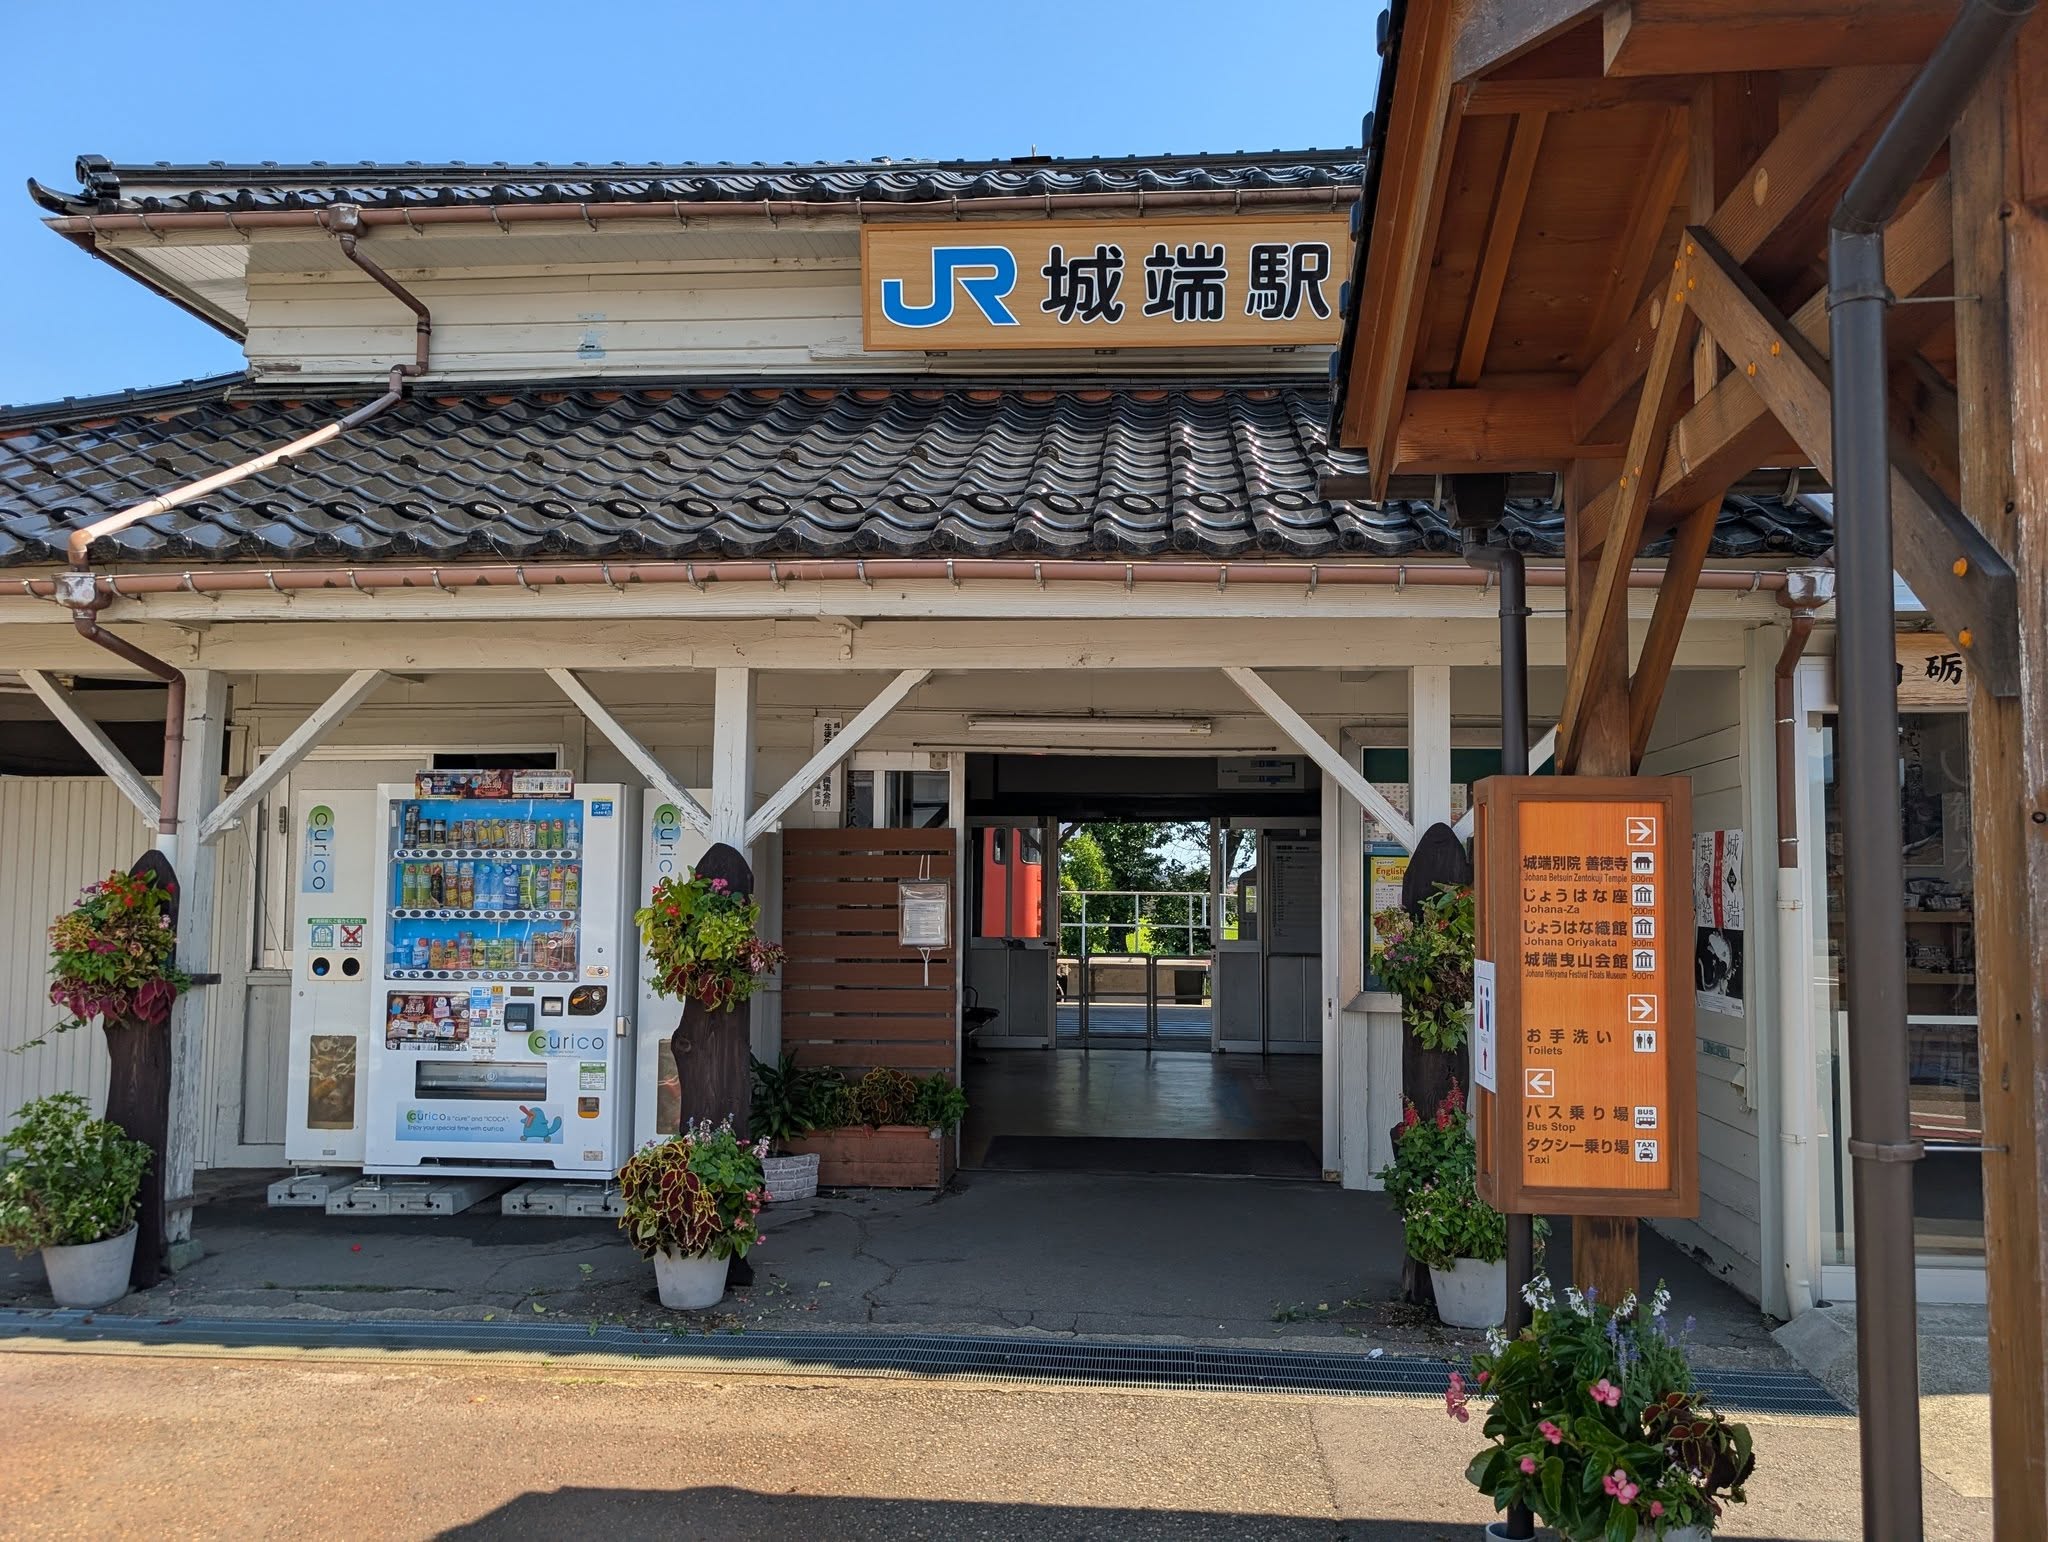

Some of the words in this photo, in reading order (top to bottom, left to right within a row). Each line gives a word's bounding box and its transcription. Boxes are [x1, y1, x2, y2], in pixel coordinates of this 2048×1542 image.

[882, 245, 1020, 328] JR
[1041, 240, 1332, 325] 城端駅
[312, 812, 330, 890] curico
[1523, 855, 1581, 871] 城端別院
[1586, 855, 1628, 872] 善徳寺
[1376, 867, 1405, 877] English
[1524, 873, 1547, 881] Johana
[1549, 873, 1573, 882] Betsuin
[1574, 873, 1603, 884] Zentokuji
[1604, 874, 1628, 884] Temple
[1523, 887, 1628, 904] じょうはな座
[1524, 904, 1580, 914] Johana-Za
[1629, 907, 1656, 915] 1200m
[1523, 919, 1628, 936] じょうはな織館
[1524, 937, 1564, 947] Johana
[1566, 937, 1617, 948] Oriyakata
[1631, 939, 1655, 947] 900m
[1524, 951, 1628, 969] 城端曳山会館
[1525, 970, 1544, 978] Johana
[1545, 970, 1568, 980] Hikiyama
[1569, 970, 1589, 979] Festival
[1606, 971, 1627, 979] Museum
[1631, 972, 1655, 980] 900m
[534, 1032, 605, 1050] curico
[1527, 1028, 1612, 1044] お手洗い
[1527, 1045, 1563, 1055] Toilets
[409, 1109, 447, 1122] curico
[1526, 1105, 1629, 1122] バス乗り場
[1527, 1122, 1548, 1131] Bus
[1551, 1122, 1576, 1133] Stop
[1527, 1137, 1630, 1155] タクシー乗り場
[1527, 1154, 1550, 1164] Taxi
